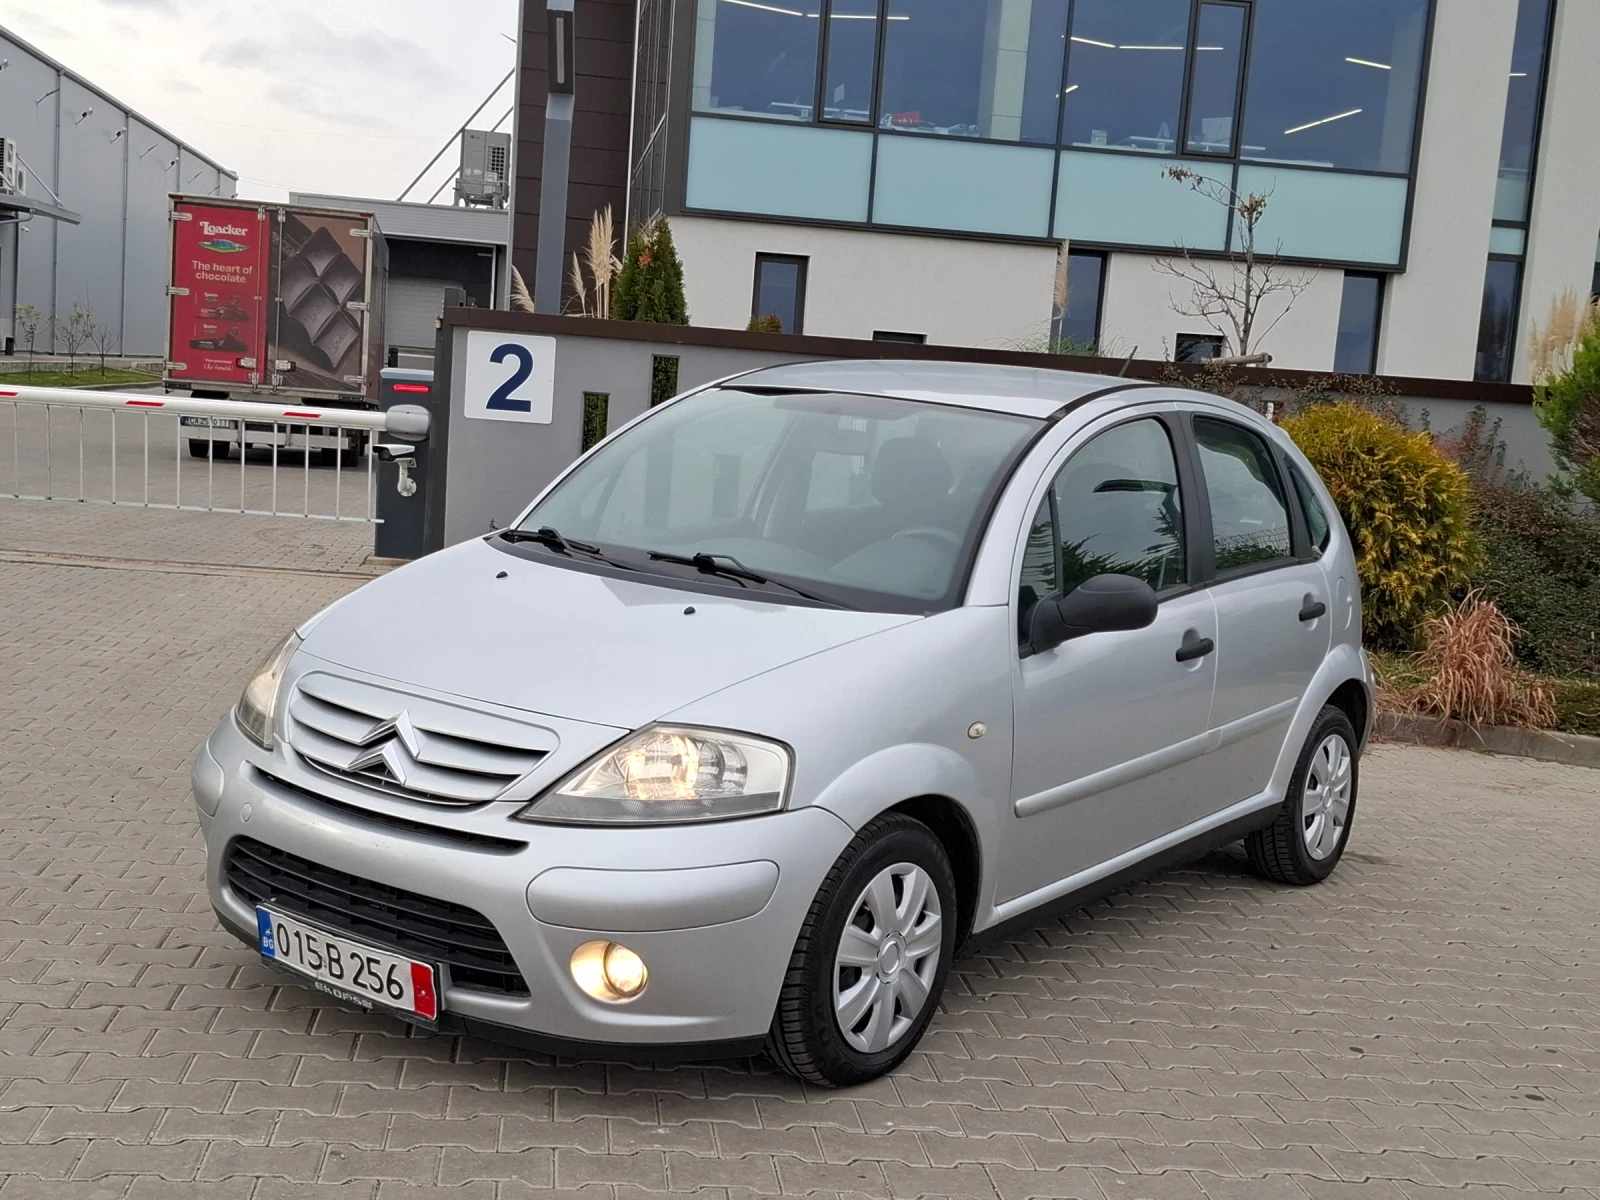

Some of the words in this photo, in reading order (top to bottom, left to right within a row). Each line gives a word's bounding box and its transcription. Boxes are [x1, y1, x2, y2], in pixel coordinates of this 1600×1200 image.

[199, 221, 249, 236] Loacker
[192, 260, 211, 271] The
[213, 262, 241, 273] heart
[242, 266, 253, 275] of
[195, 271, 249, 284] chocolate.
[486, 343, 533, 413] 2
[200, 417, 217, 426] 250
[263, 936, 274, 950] BG
